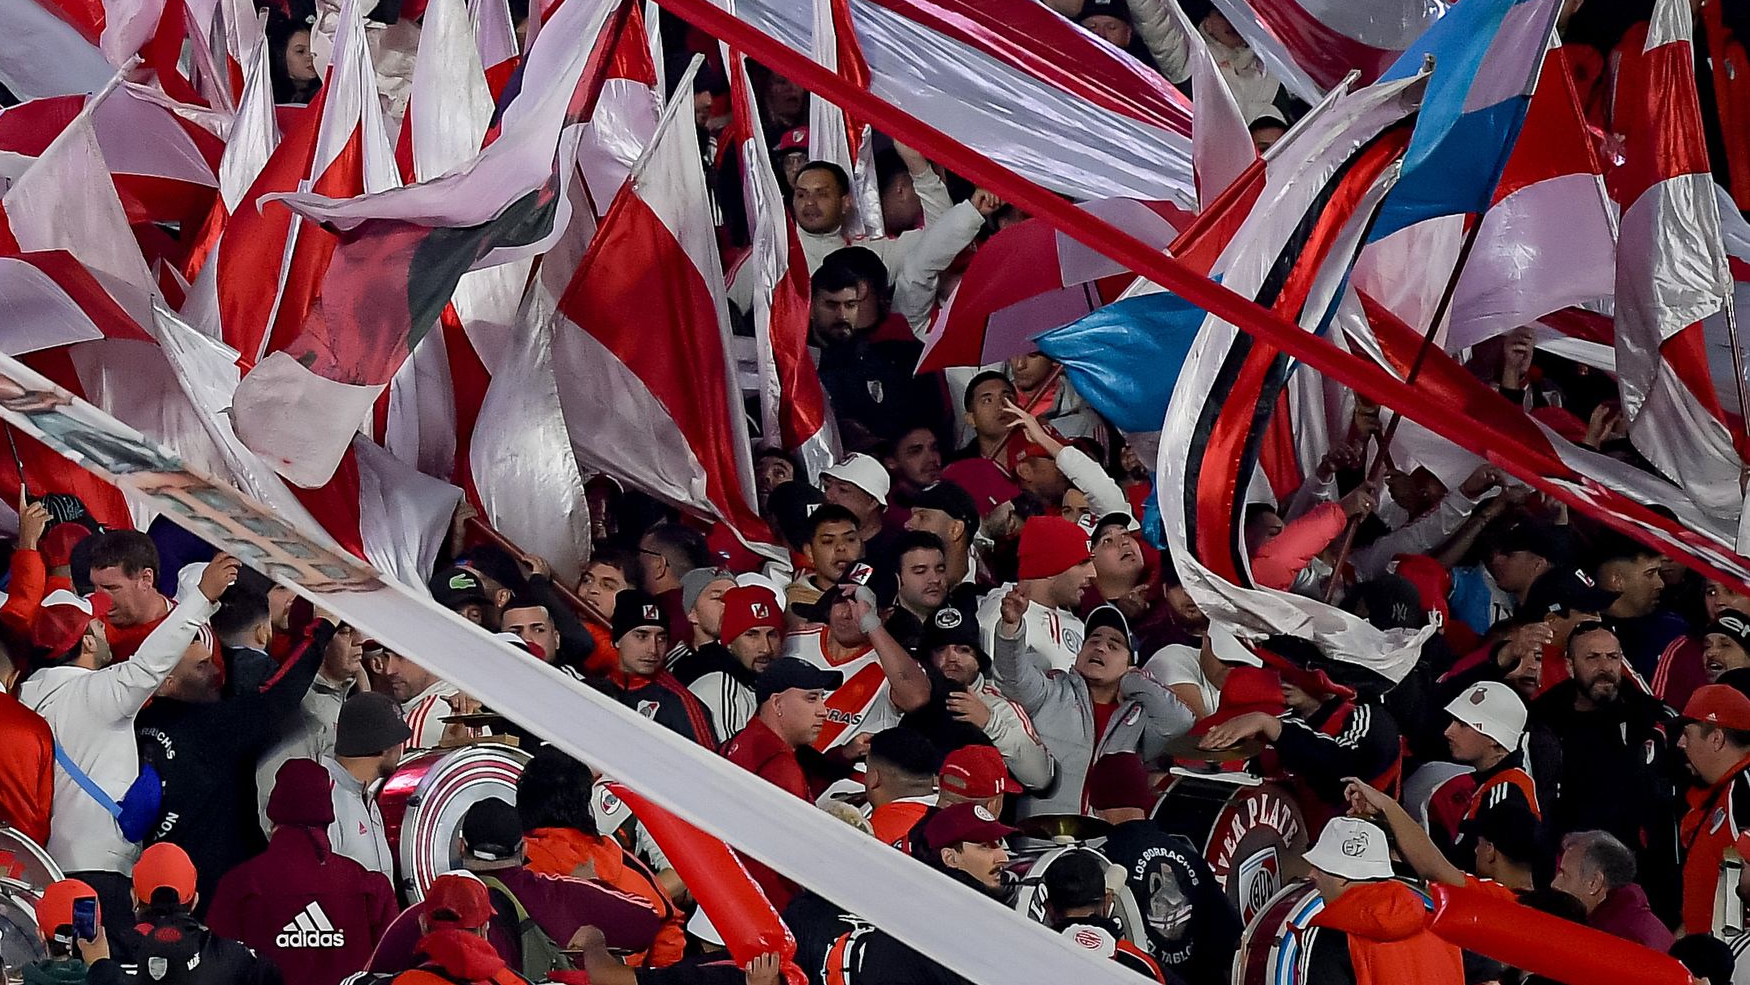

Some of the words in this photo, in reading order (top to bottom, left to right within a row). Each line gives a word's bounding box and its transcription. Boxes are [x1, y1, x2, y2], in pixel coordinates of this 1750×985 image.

[153, 811, 180, 841] LON
[1247, 794, 1299, 849] PLATE
[1133, 858, 1148, 882] LOS
[276, 929, 345, 948] adidas
